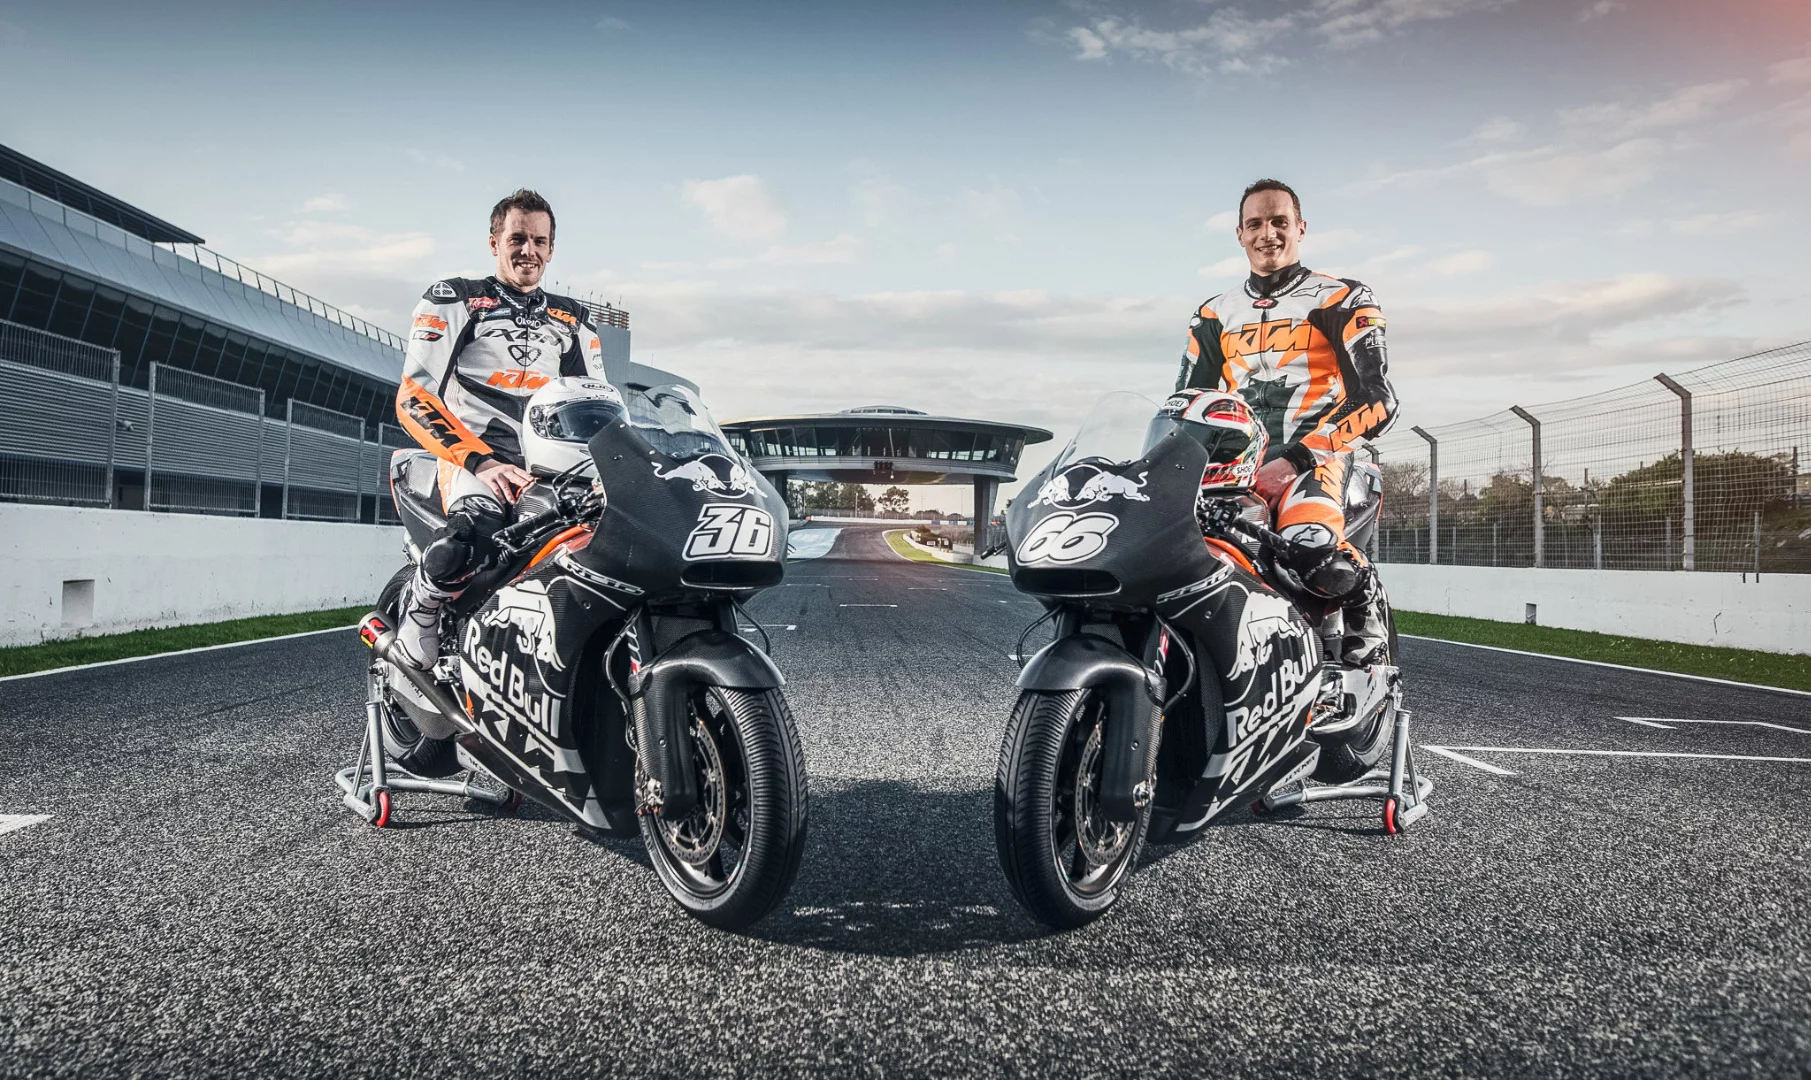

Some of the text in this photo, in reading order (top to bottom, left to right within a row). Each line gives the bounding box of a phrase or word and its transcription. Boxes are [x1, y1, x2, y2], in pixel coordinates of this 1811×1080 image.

[1227, 318, 1312, 359] KTM
[486, 369, 550, 390] KTM
[400, 396, 463, 449] KTM
[1329, 400, 1388, 453] KTM
[682, 503, 774, 561] 36
[1015, 511, 1120, 566] 66
[464, 617, 561, 739] Red Bull
[1226, 627, 1319, 749] Red Bull
